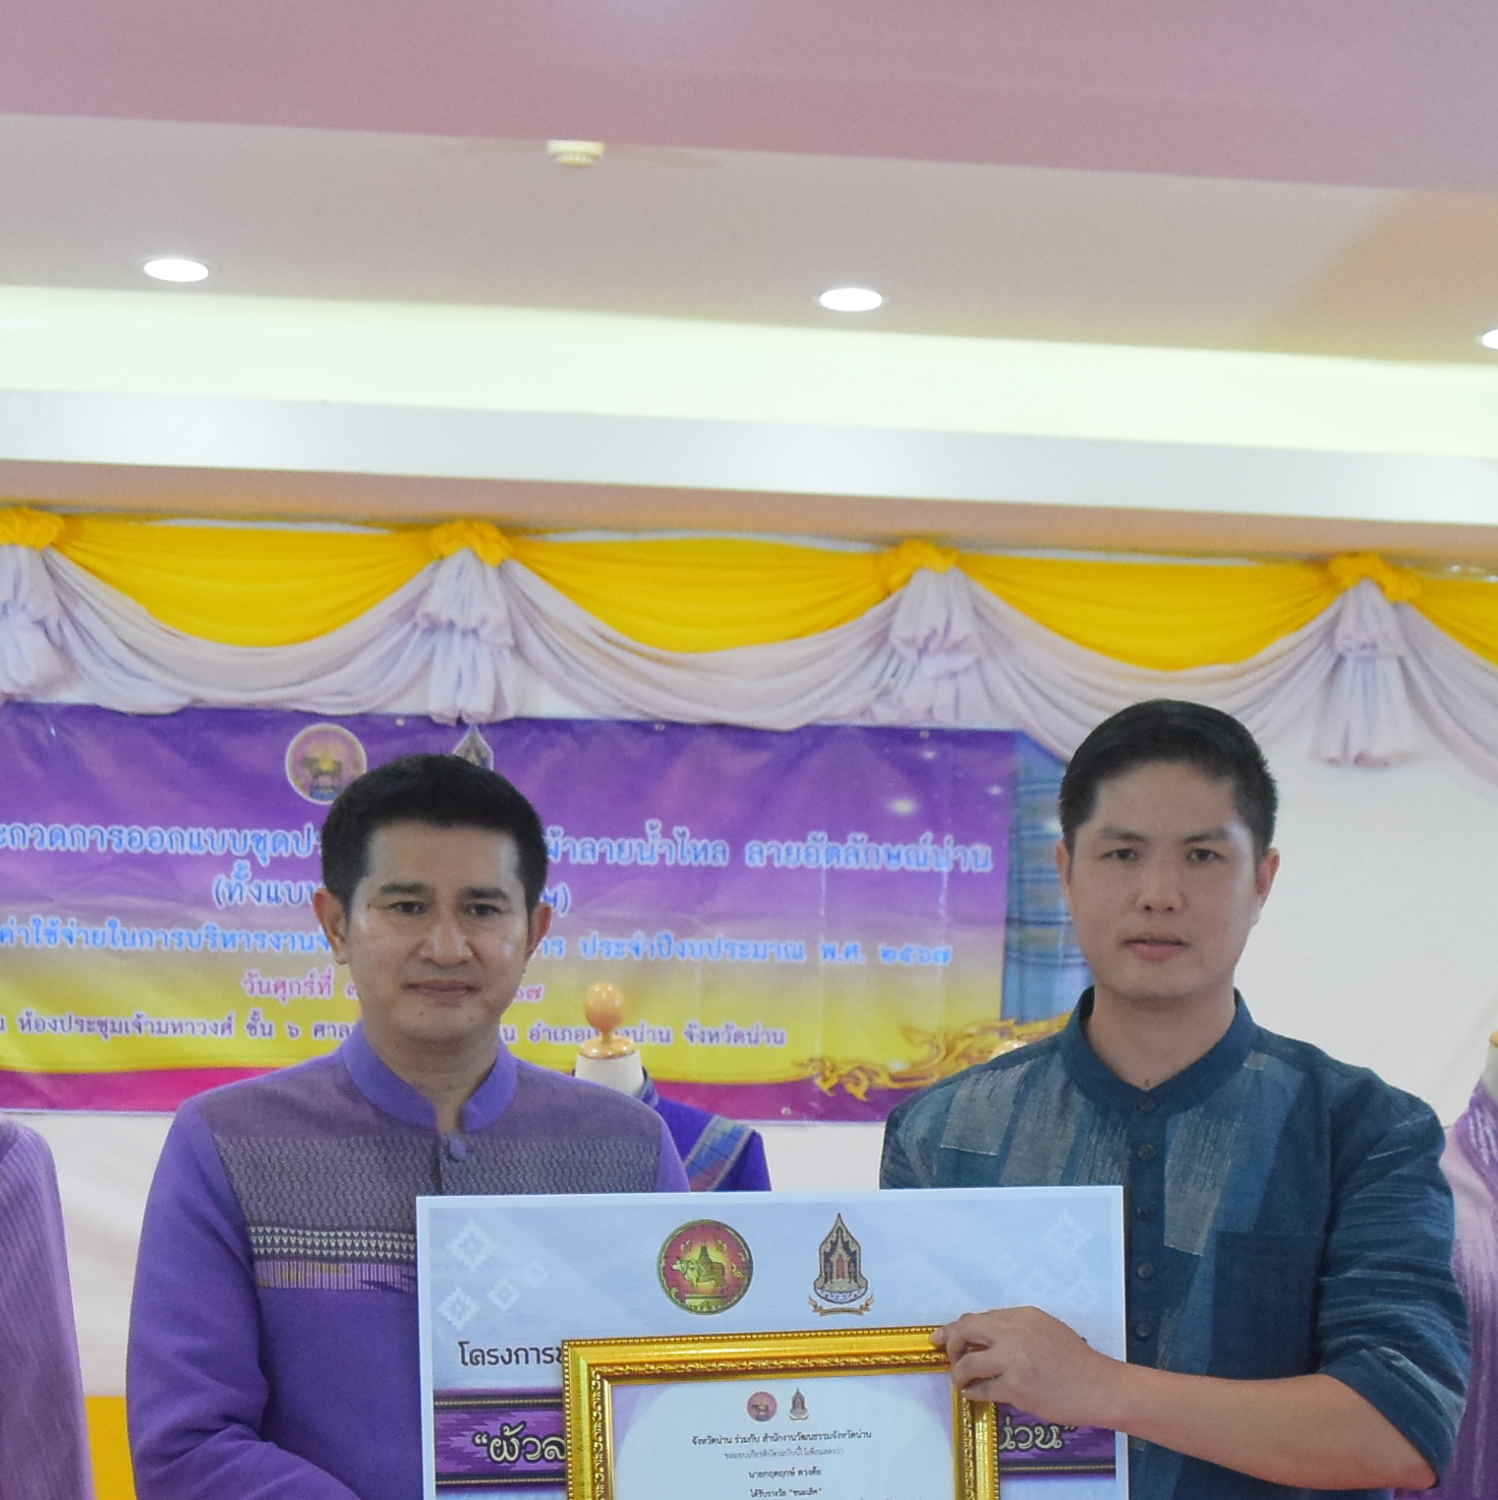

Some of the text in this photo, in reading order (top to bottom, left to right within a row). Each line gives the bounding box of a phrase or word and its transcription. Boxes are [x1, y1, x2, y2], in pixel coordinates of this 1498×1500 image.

[746, 831, 992, 873] ลายอัตลักษณ์น่าน
[580, 932, 805, 963] ประจำปีงบประมาณ
[820, 942, 866, 964] พ.ศ.
[245, 1008, 274, 1038] ชั้น
[312, 1022, 351, 1038] ศาล
[684, 1020, 787, 1046] จังหวัดน่าน
[692, 1434, 732, 1446] จังหวัดน่าน
[734, 1432, 761, 1445] ร่วมกับ
